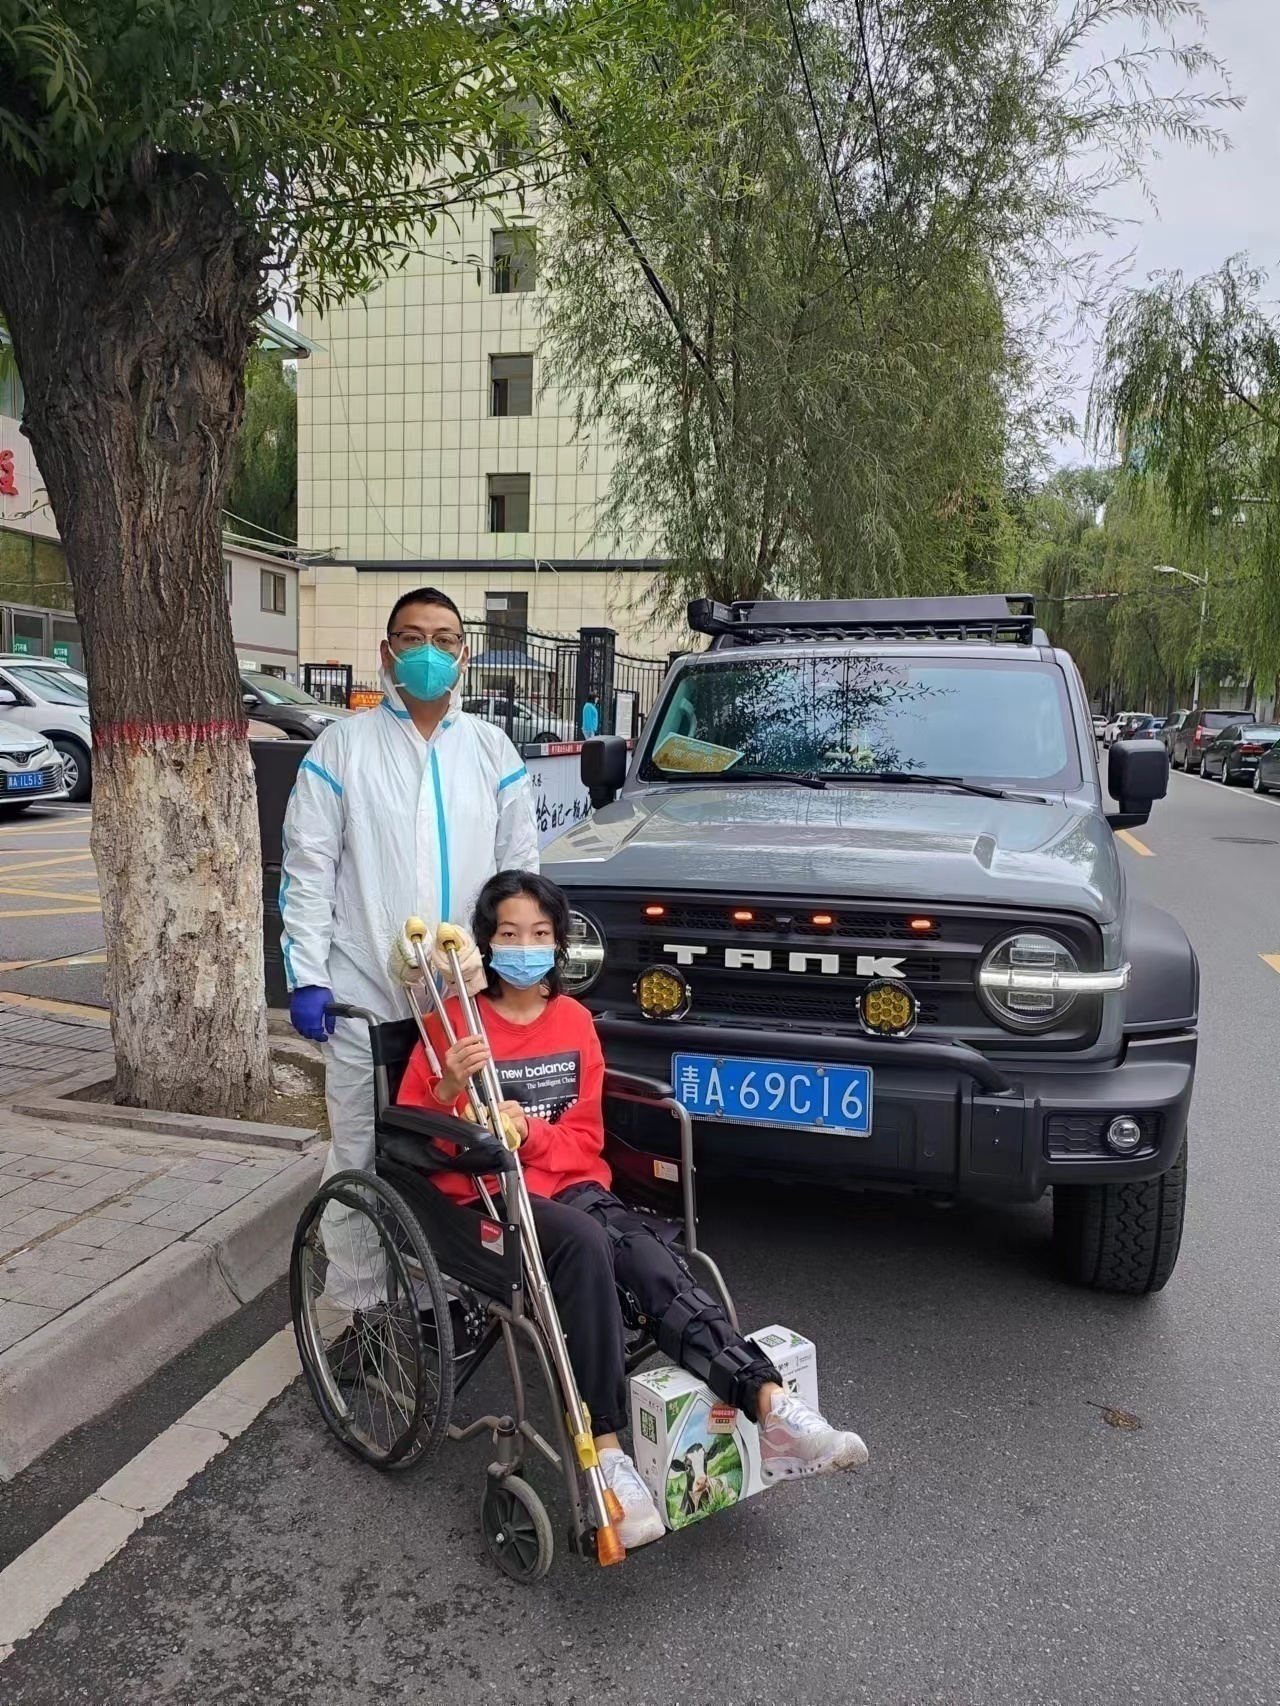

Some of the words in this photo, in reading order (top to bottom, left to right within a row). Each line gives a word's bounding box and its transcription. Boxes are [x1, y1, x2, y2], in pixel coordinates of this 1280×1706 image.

[663, 944, 908, 978] TANK
[501, 1068, 523, 1080] new
[525, 1061, 576, 1078] balance
[537, 1078, 562, 1088] Intelligent
